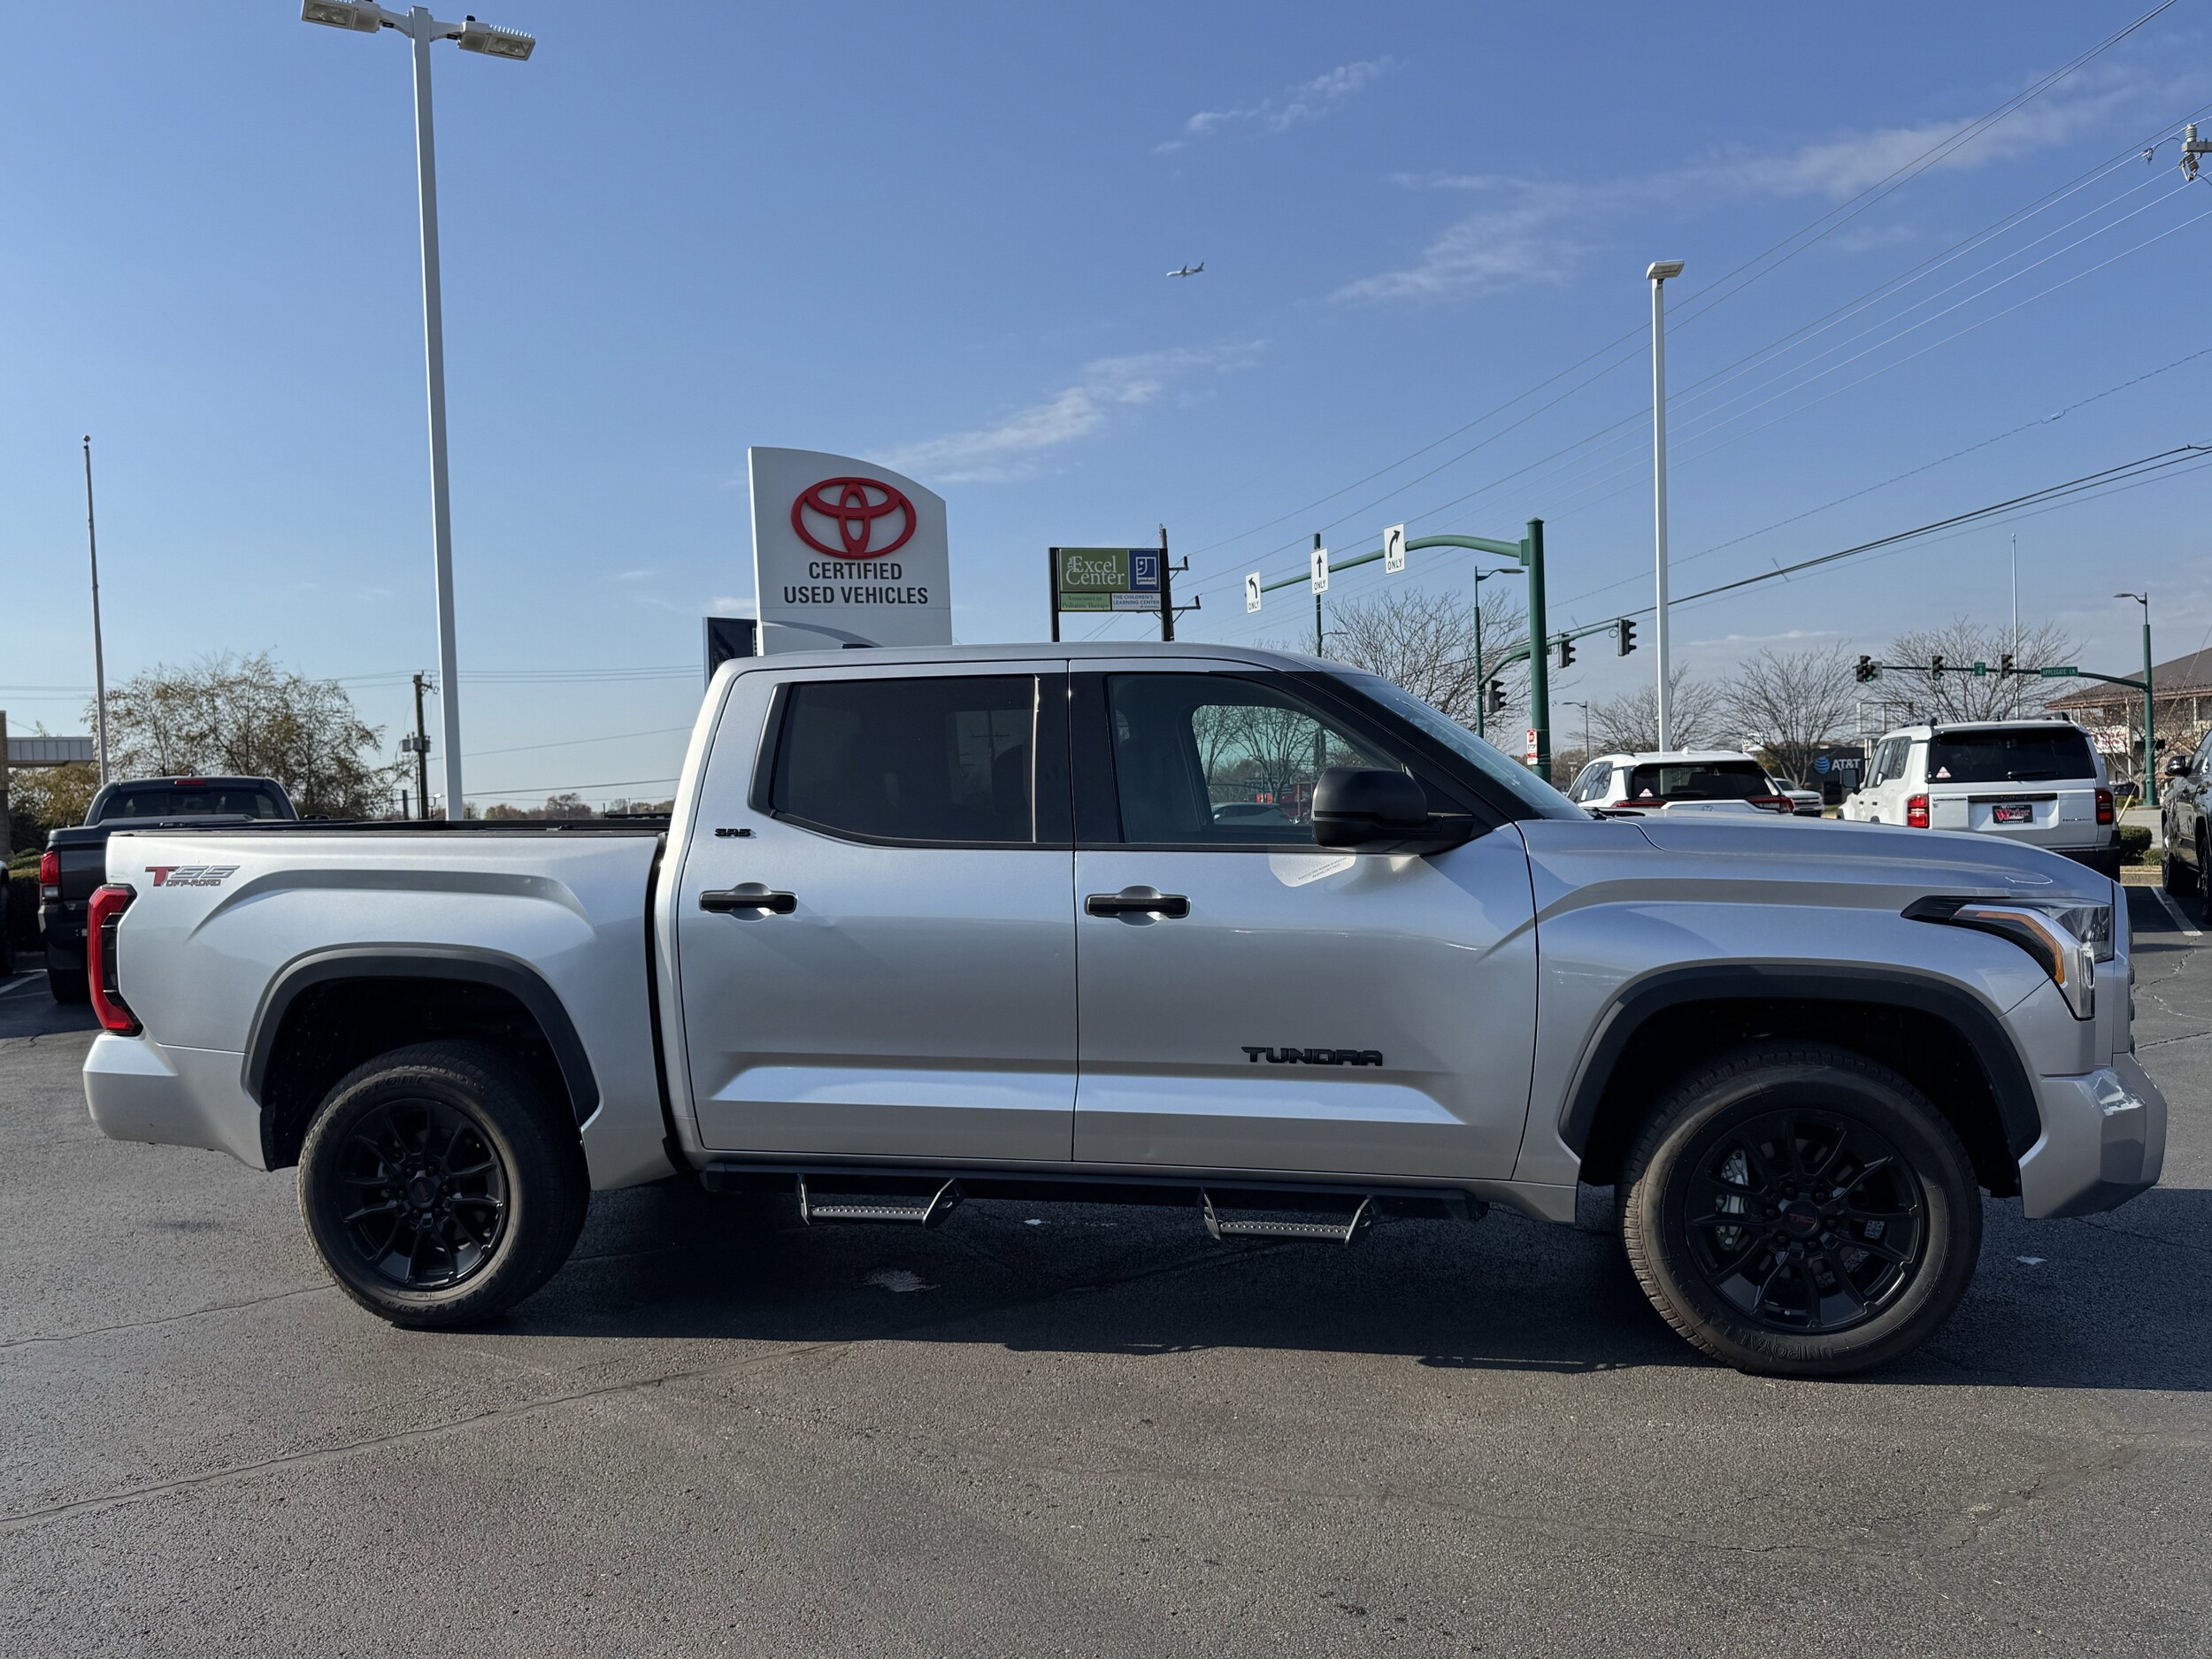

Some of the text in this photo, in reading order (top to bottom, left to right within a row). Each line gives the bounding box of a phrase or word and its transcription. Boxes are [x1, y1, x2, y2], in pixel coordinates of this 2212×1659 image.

[809, 562, 902, 580] CERTIFIED
[1071, 556, 1118, 572] Excel
[1387, 558, 1402, 570] ONLY
[1065, 568, 1125, 584] Center
[1313, 580, 1326, 590] ONLY
[784, 586, 928, 604] USED VEHICLES
[1248, 601, 1260, 611] ONLY
[1832, 758, 1861, 771] AT&T
[715, 828, 751, 837] SR5
[1241, 1047, 1383, 1066] TUNDRA
[1787, 1213, 1816, 1224] TRD
[1736, 1330, 1835, 1360] UNIROYAL
